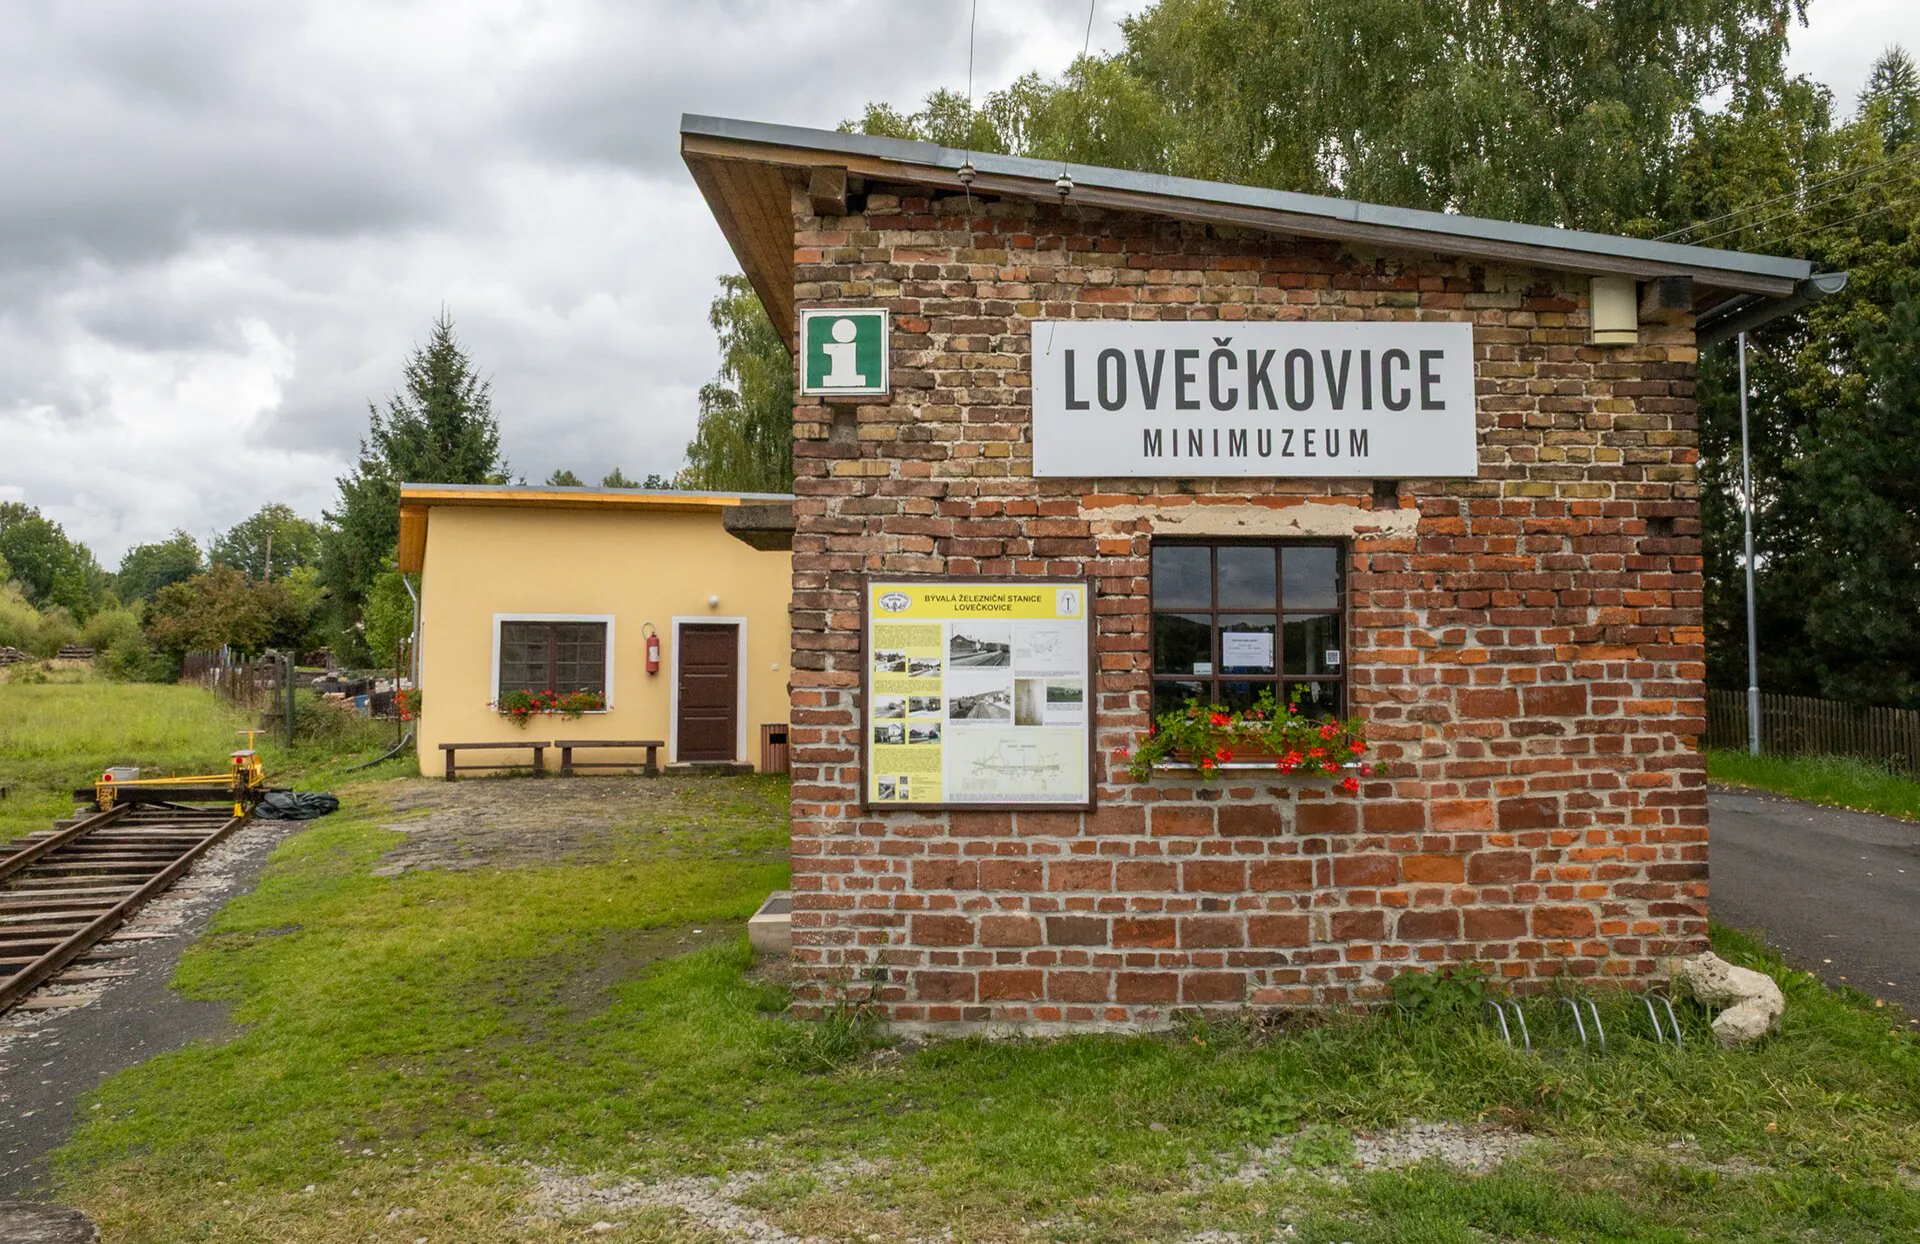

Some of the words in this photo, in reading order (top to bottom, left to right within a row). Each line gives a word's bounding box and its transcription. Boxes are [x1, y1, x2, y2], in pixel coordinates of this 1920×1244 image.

[1064, 337, 1446, 412] LOVEČKOVICE
[1143, 428, 1370, 458] MINIMUZEUM
[924, 594, 957, 602] BÝVALÁ
[959, 594, 1006, 602] ŽELEZNIČNÍ
[954, 603, 1012, 611] LOVEČKOVICE
